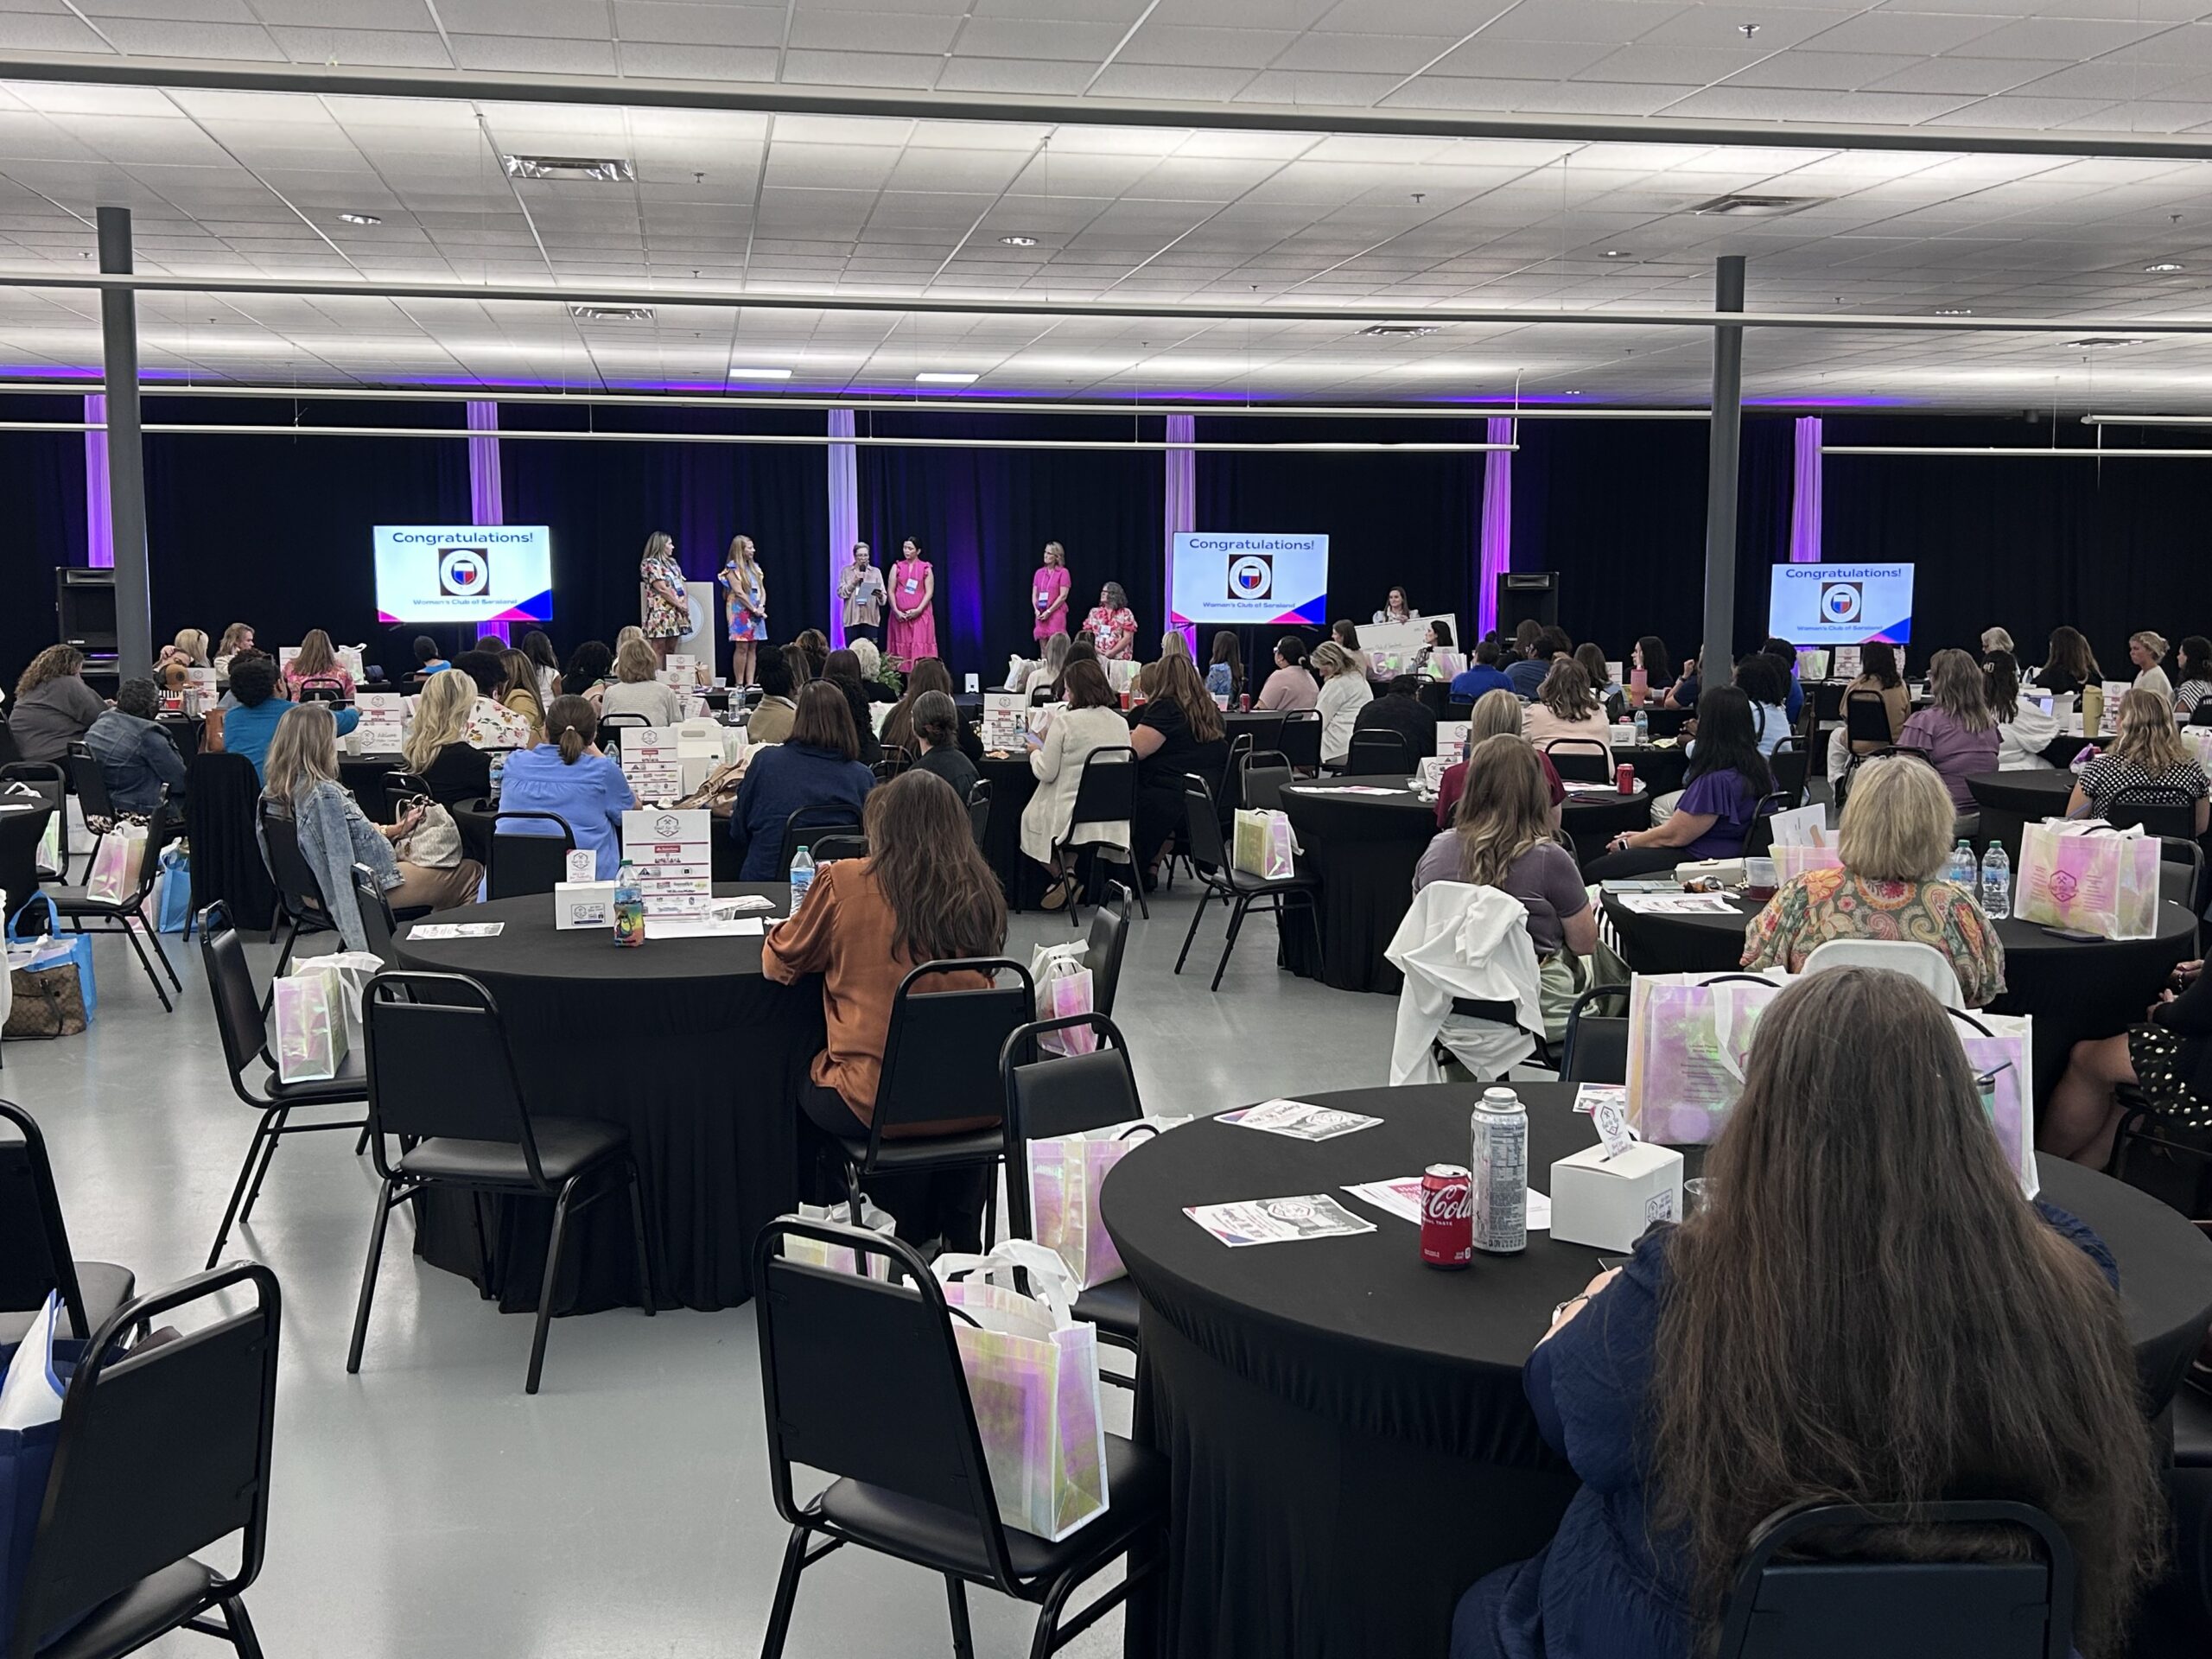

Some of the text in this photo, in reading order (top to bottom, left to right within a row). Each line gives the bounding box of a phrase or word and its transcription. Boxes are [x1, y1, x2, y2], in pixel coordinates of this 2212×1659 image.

[392, 532, 533, 545] Congratulations!
[1189, 538, 1314, 551] Congratulations!
[1785, 568, 1901, 580] Congratulations!
